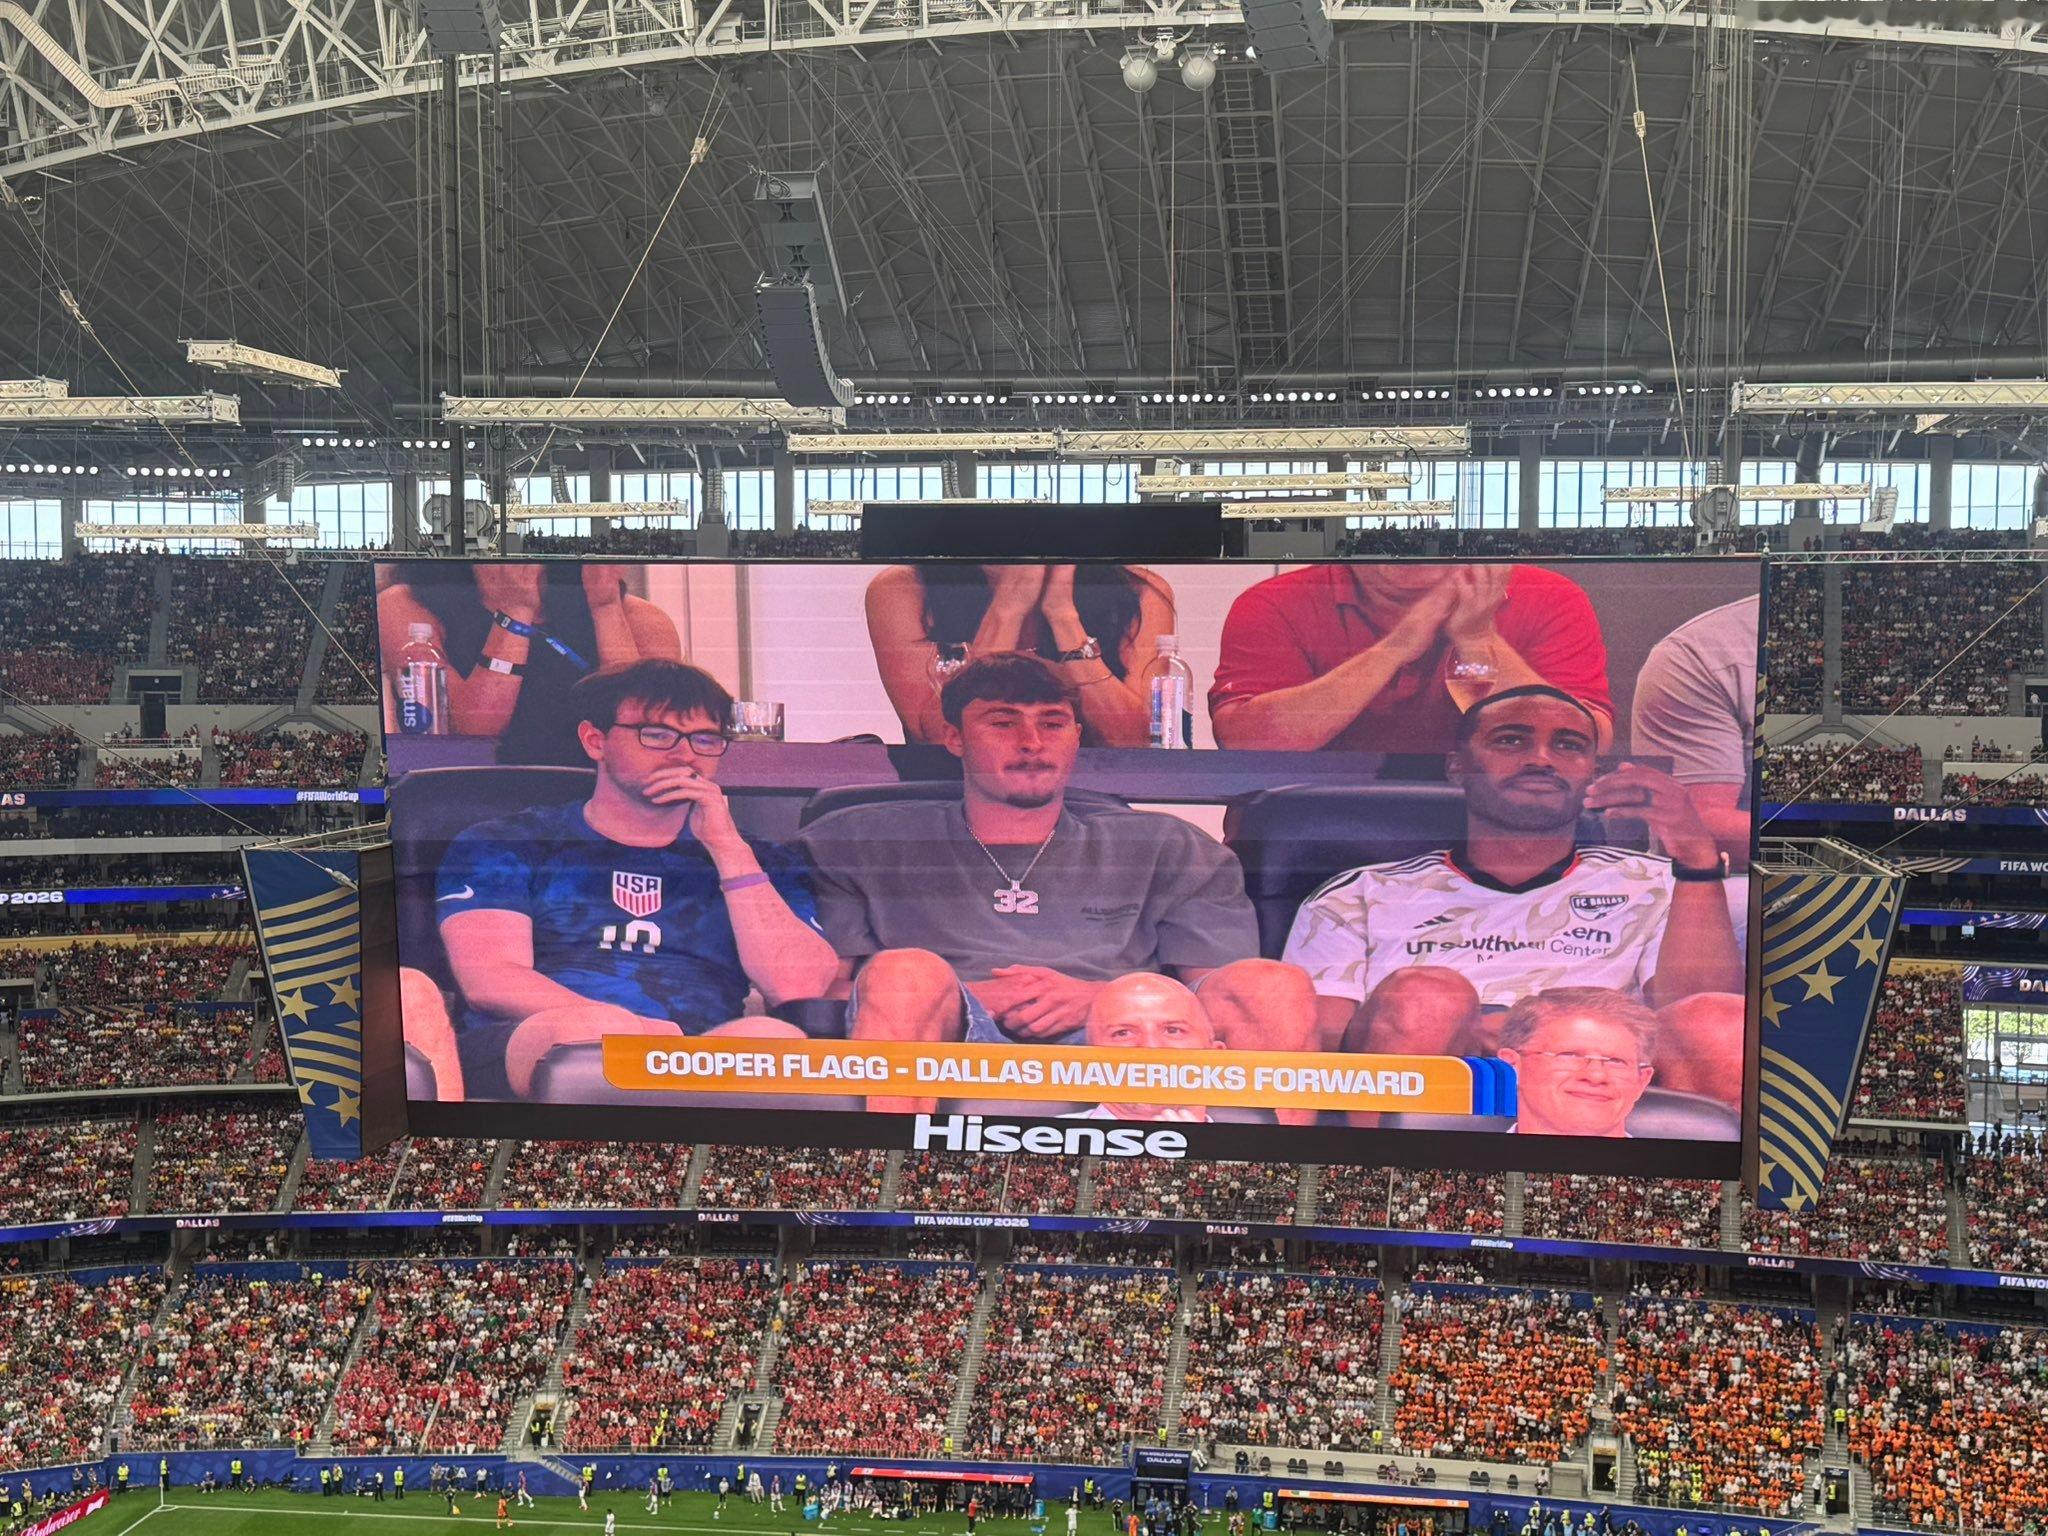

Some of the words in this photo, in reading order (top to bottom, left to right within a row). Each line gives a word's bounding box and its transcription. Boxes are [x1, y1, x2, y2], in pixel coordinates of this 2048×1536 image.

[401, 674, 417, 728] smart
[1894, 807, 1967, 822] DALLAS
[2000, 861, 2028, 872] FIFA
[616, 873, 659, 894] USA
[11, 891, 64, 904] 2026
[993, 888, 1039, 914] 32
[1550, 939, 1612, 957] Center
[2019, 979, 2048, 993] DA
[645, 1050, 777, 1077] COOPER
[783, 1054, 889, 1081] FLAGG
[916, 1057, 1044, 1085] DALLAS
[1051, 1061, 1247, 1091] MAVERICKS
[1254, 1067, 1425, 1096] FORWARD
[912, 1114, 1189, 1159] Hisense
[176, 1218, 220, 1228] DALLAS
[698, 1213, 740, 1222] DALLAS
[914, 1216, 936, 1225] FIFA
[937, 1216, 972, 1226] WORLD
[973, 1217, 993, 1226] CUP
[994, 1218, 1029, 1227] 2026
[1206, 1225, 1249, 1235] DALLAS
[1748, 1256, 1795, 1269] DALLAS
[2000, 1275, 2026, 1287] FIFA
[1146, 1456, 1182, 1464] DALLAS
